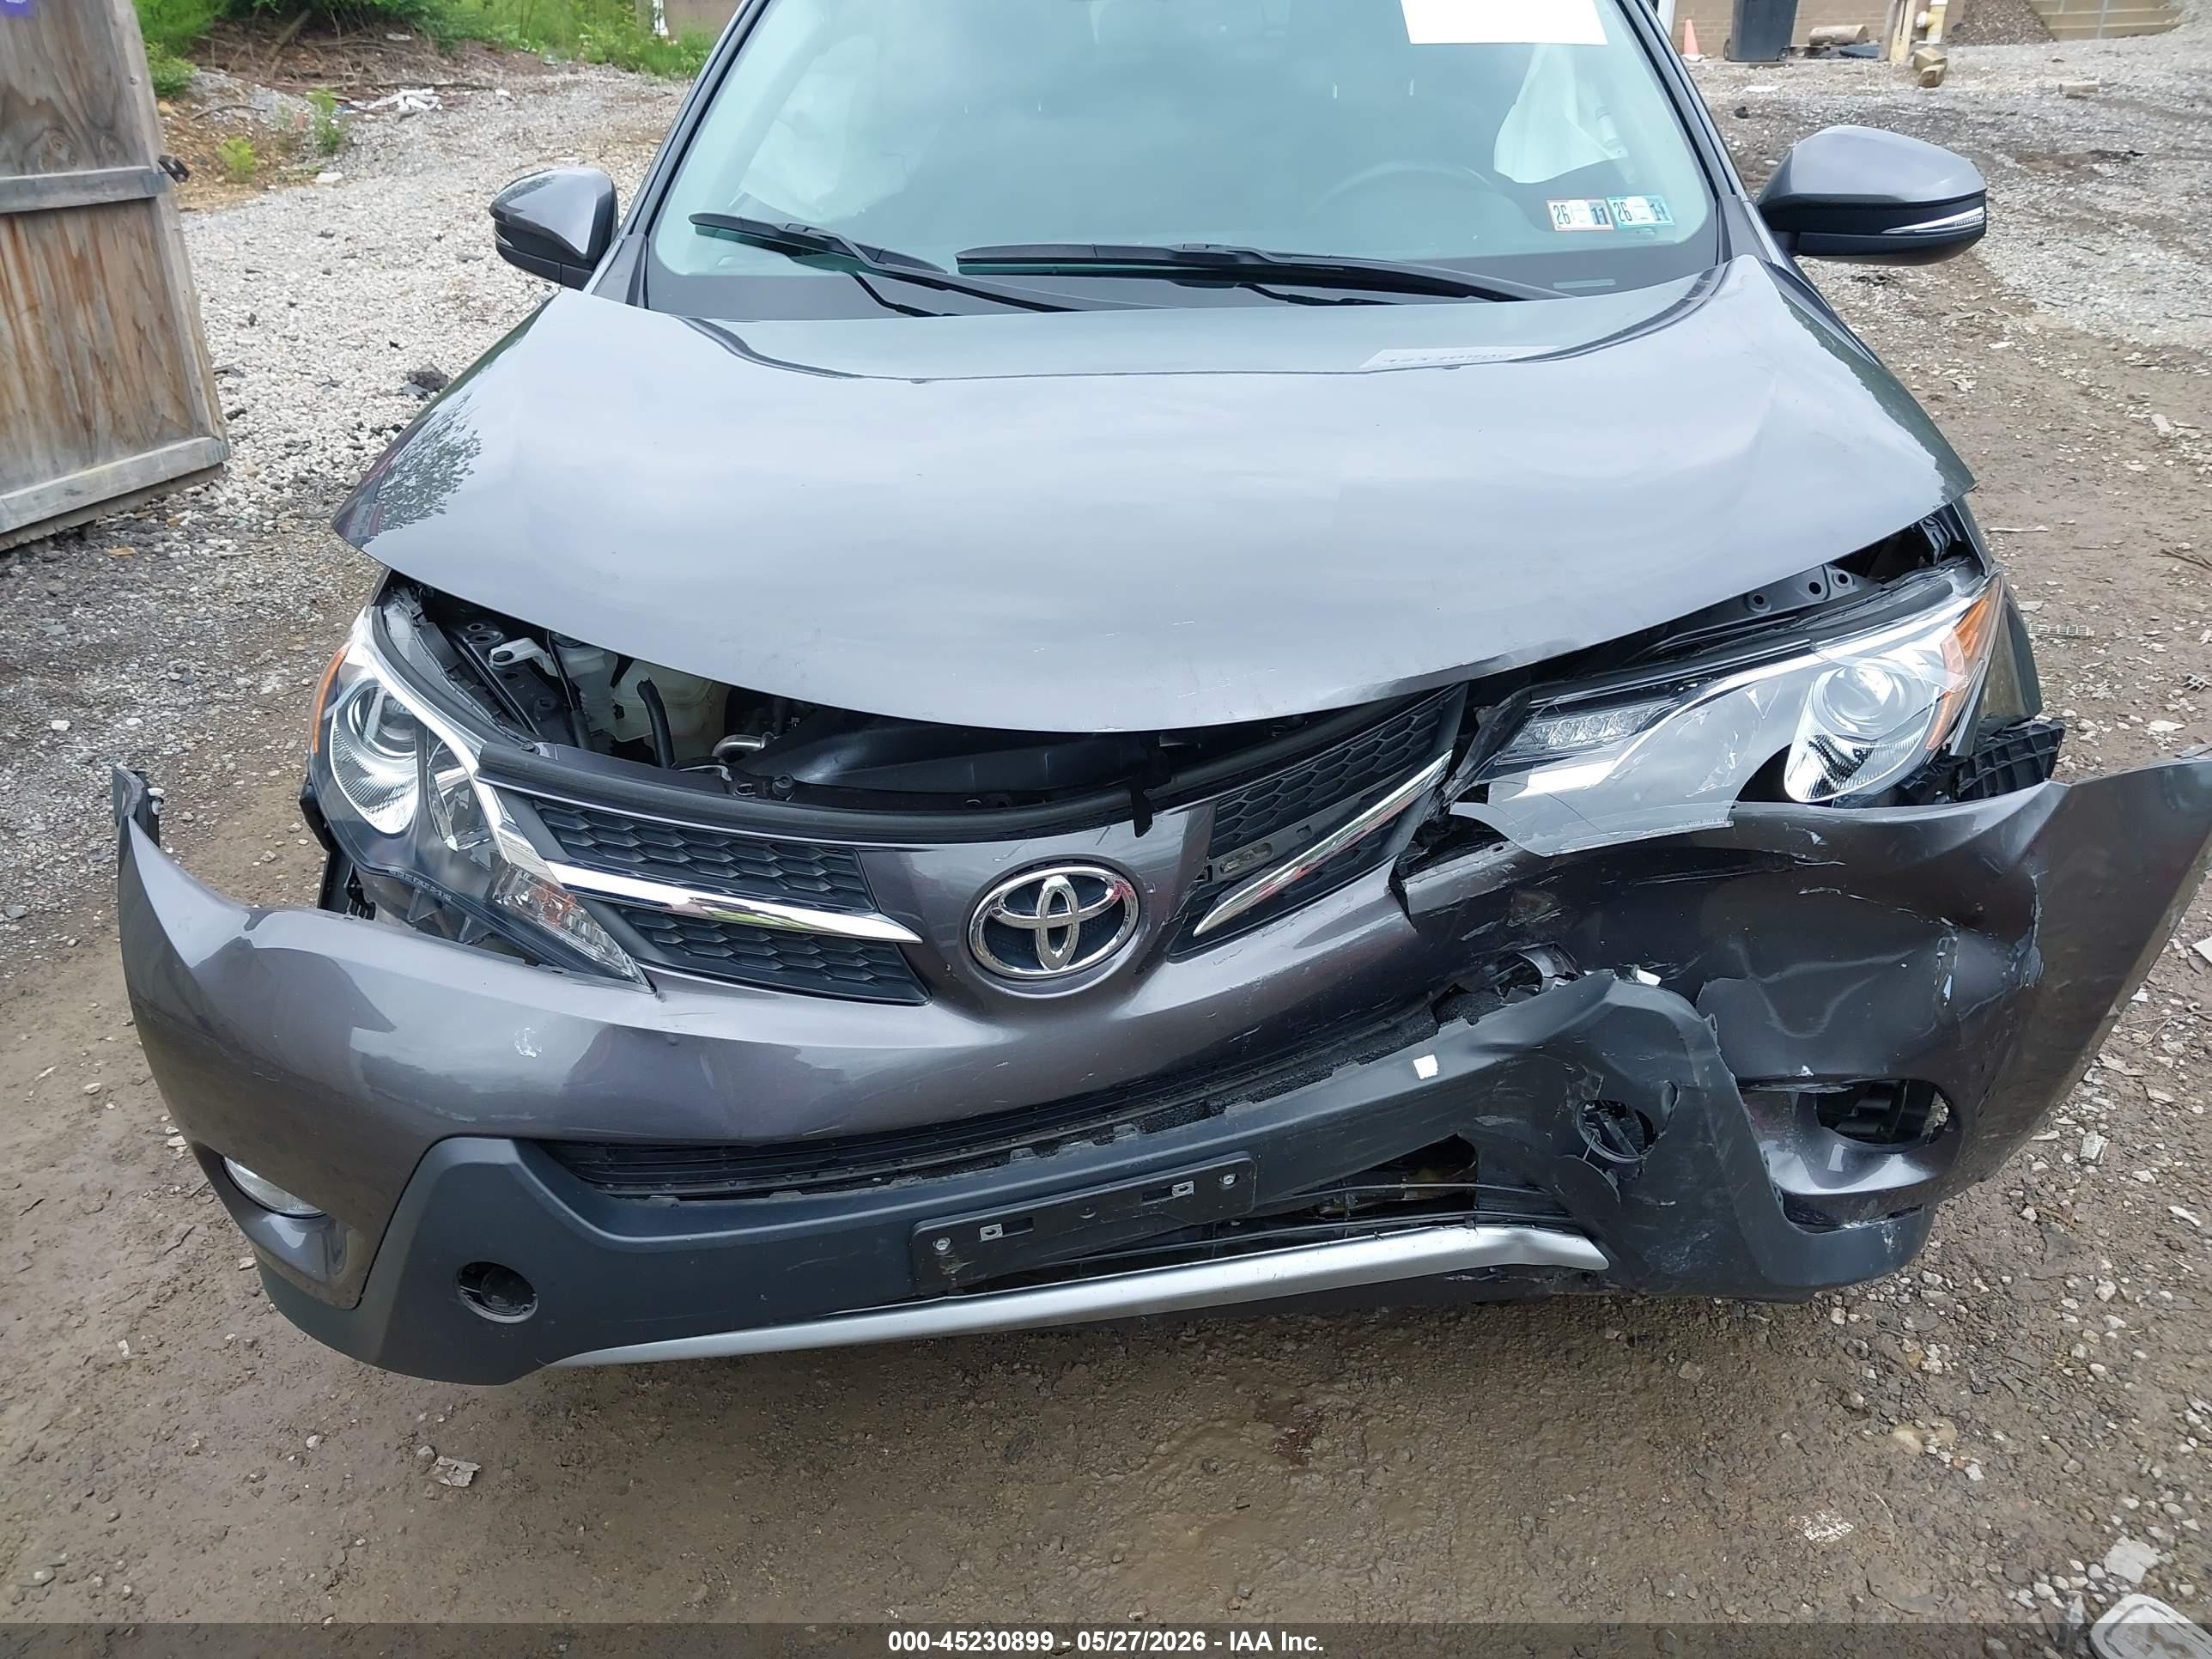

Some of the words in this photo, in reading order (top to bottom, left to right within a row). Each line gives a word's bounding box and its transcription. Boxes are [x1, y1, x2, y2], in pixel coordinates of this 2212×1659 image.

[1553, 204, 1571, 225] 26
[1590, 207, 1609, 225] 11
[1613, 202, 1632, 222] 26
[1650, 203, 1669, 221] 11
